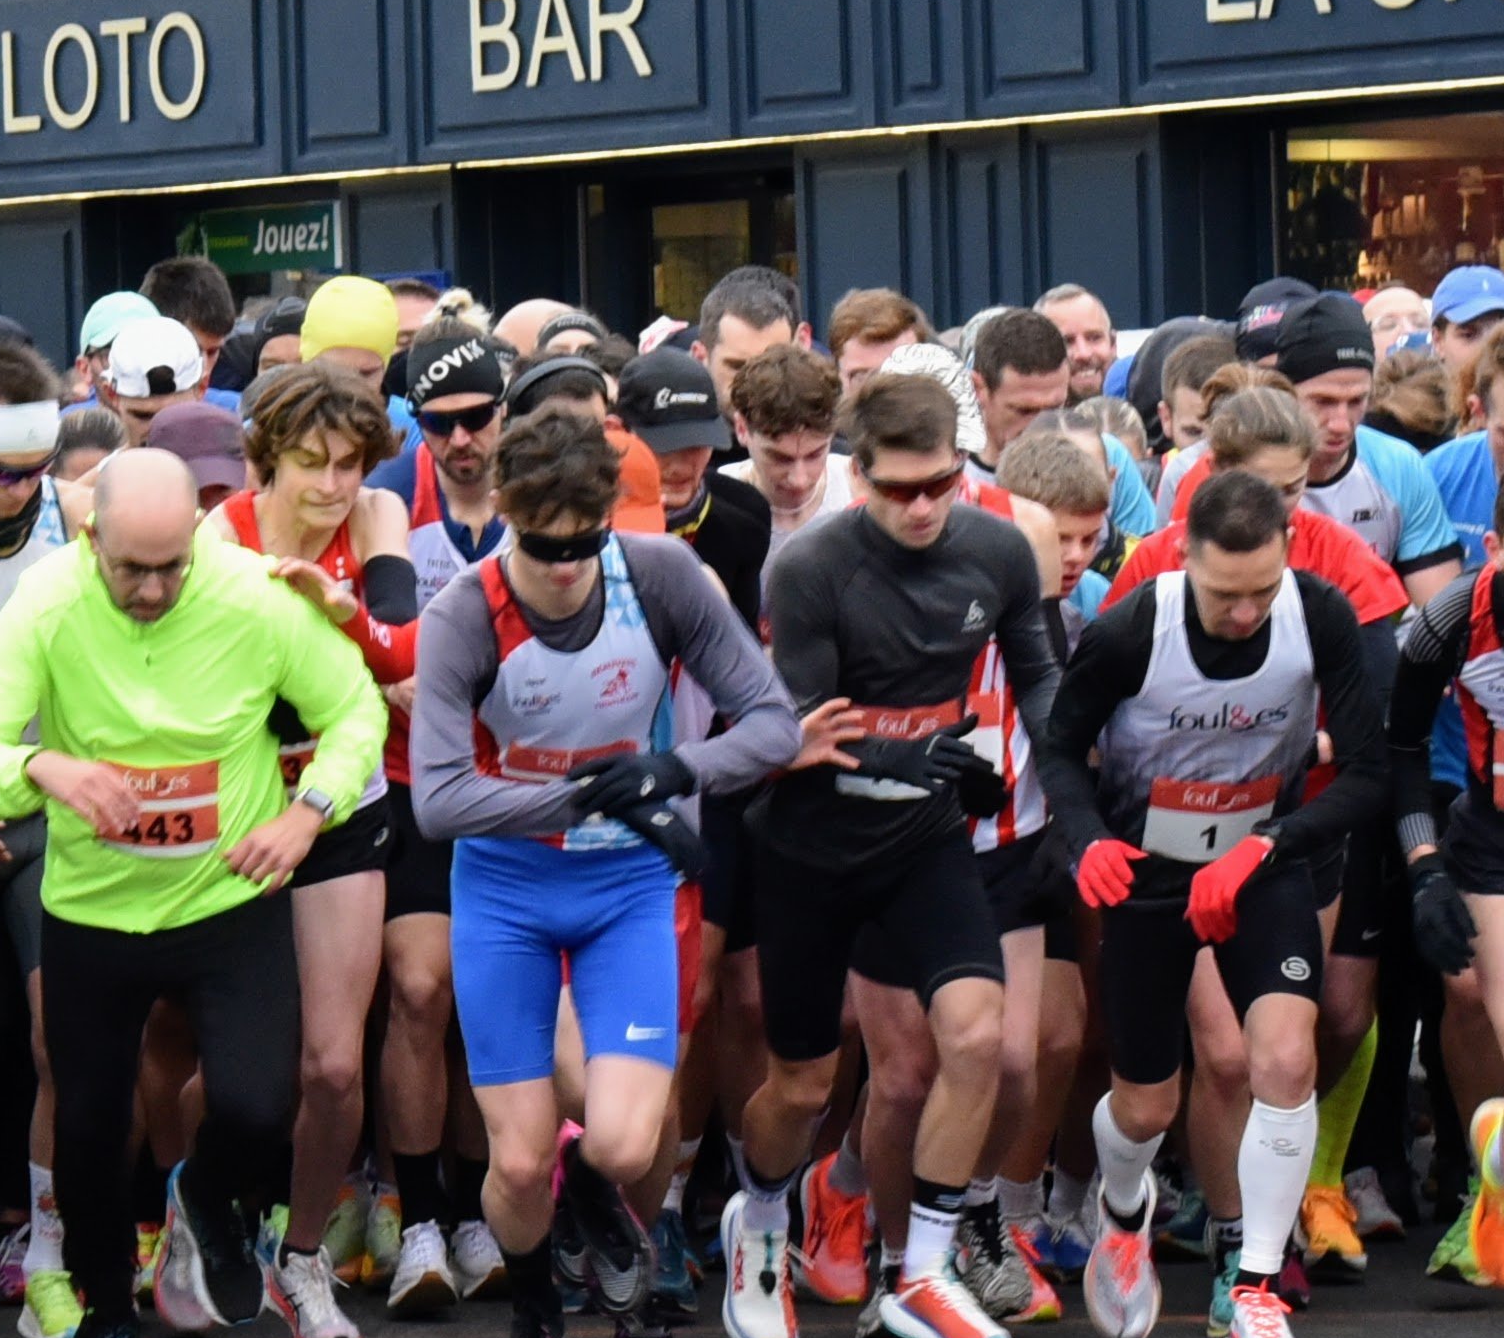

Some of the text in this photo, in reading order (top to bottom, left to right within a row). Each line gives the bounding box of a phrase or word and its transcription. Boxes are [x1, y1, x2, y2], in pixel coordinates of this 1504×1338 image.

[1, 11, 206, 136] LOTO
[252, 214, 330, 256] Jouez!
[876, 712, 940, 740] foules
[1169, 699, 1292, 733] foul&es
[1182, 786, 1251, 812] foules
[1200, 824, 1218, 851] 1
